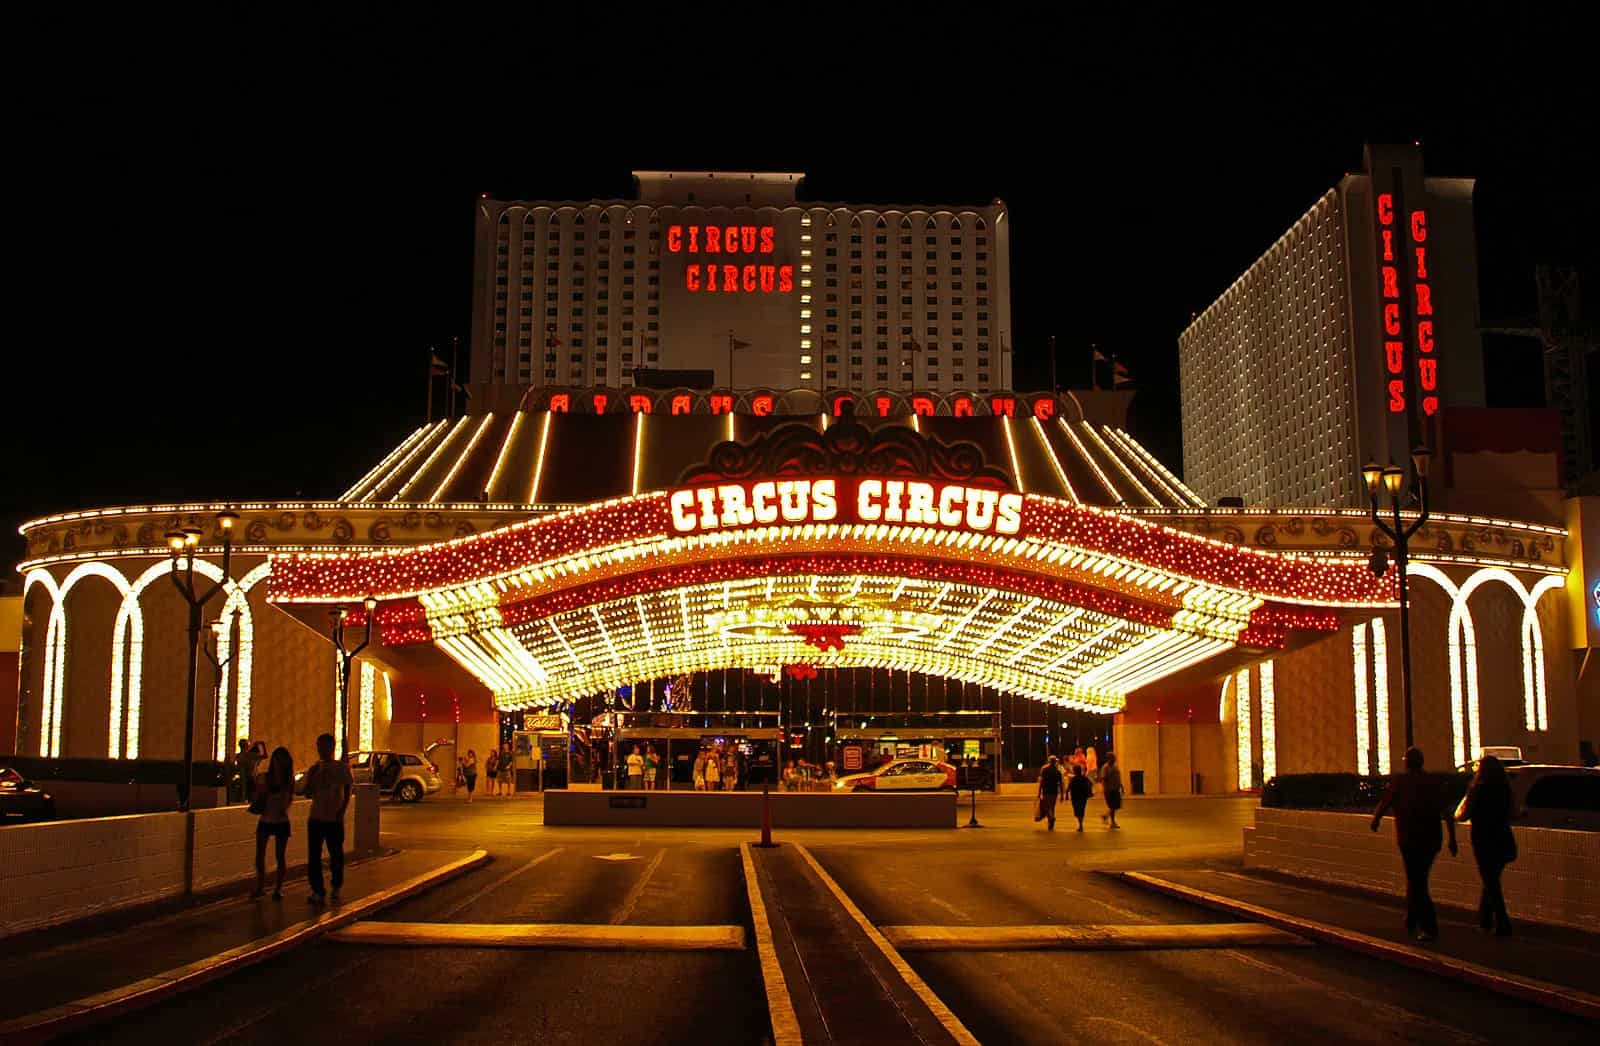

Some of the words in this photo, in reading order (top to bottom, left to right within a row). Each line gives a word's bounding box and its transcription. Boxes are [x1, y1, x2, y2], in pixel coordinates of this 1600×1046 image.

[667, 225, 775, 254] CIRCUS
[686, 264, 793, 293] CIRCUS
[1378, 193, 1406, 412] CIRCUS
[1411, 210, 1438, 416] CIRCUS
[670, 479, 838, 532] CIRCUS
[857, 479, 1023, 535] CIRCUS
